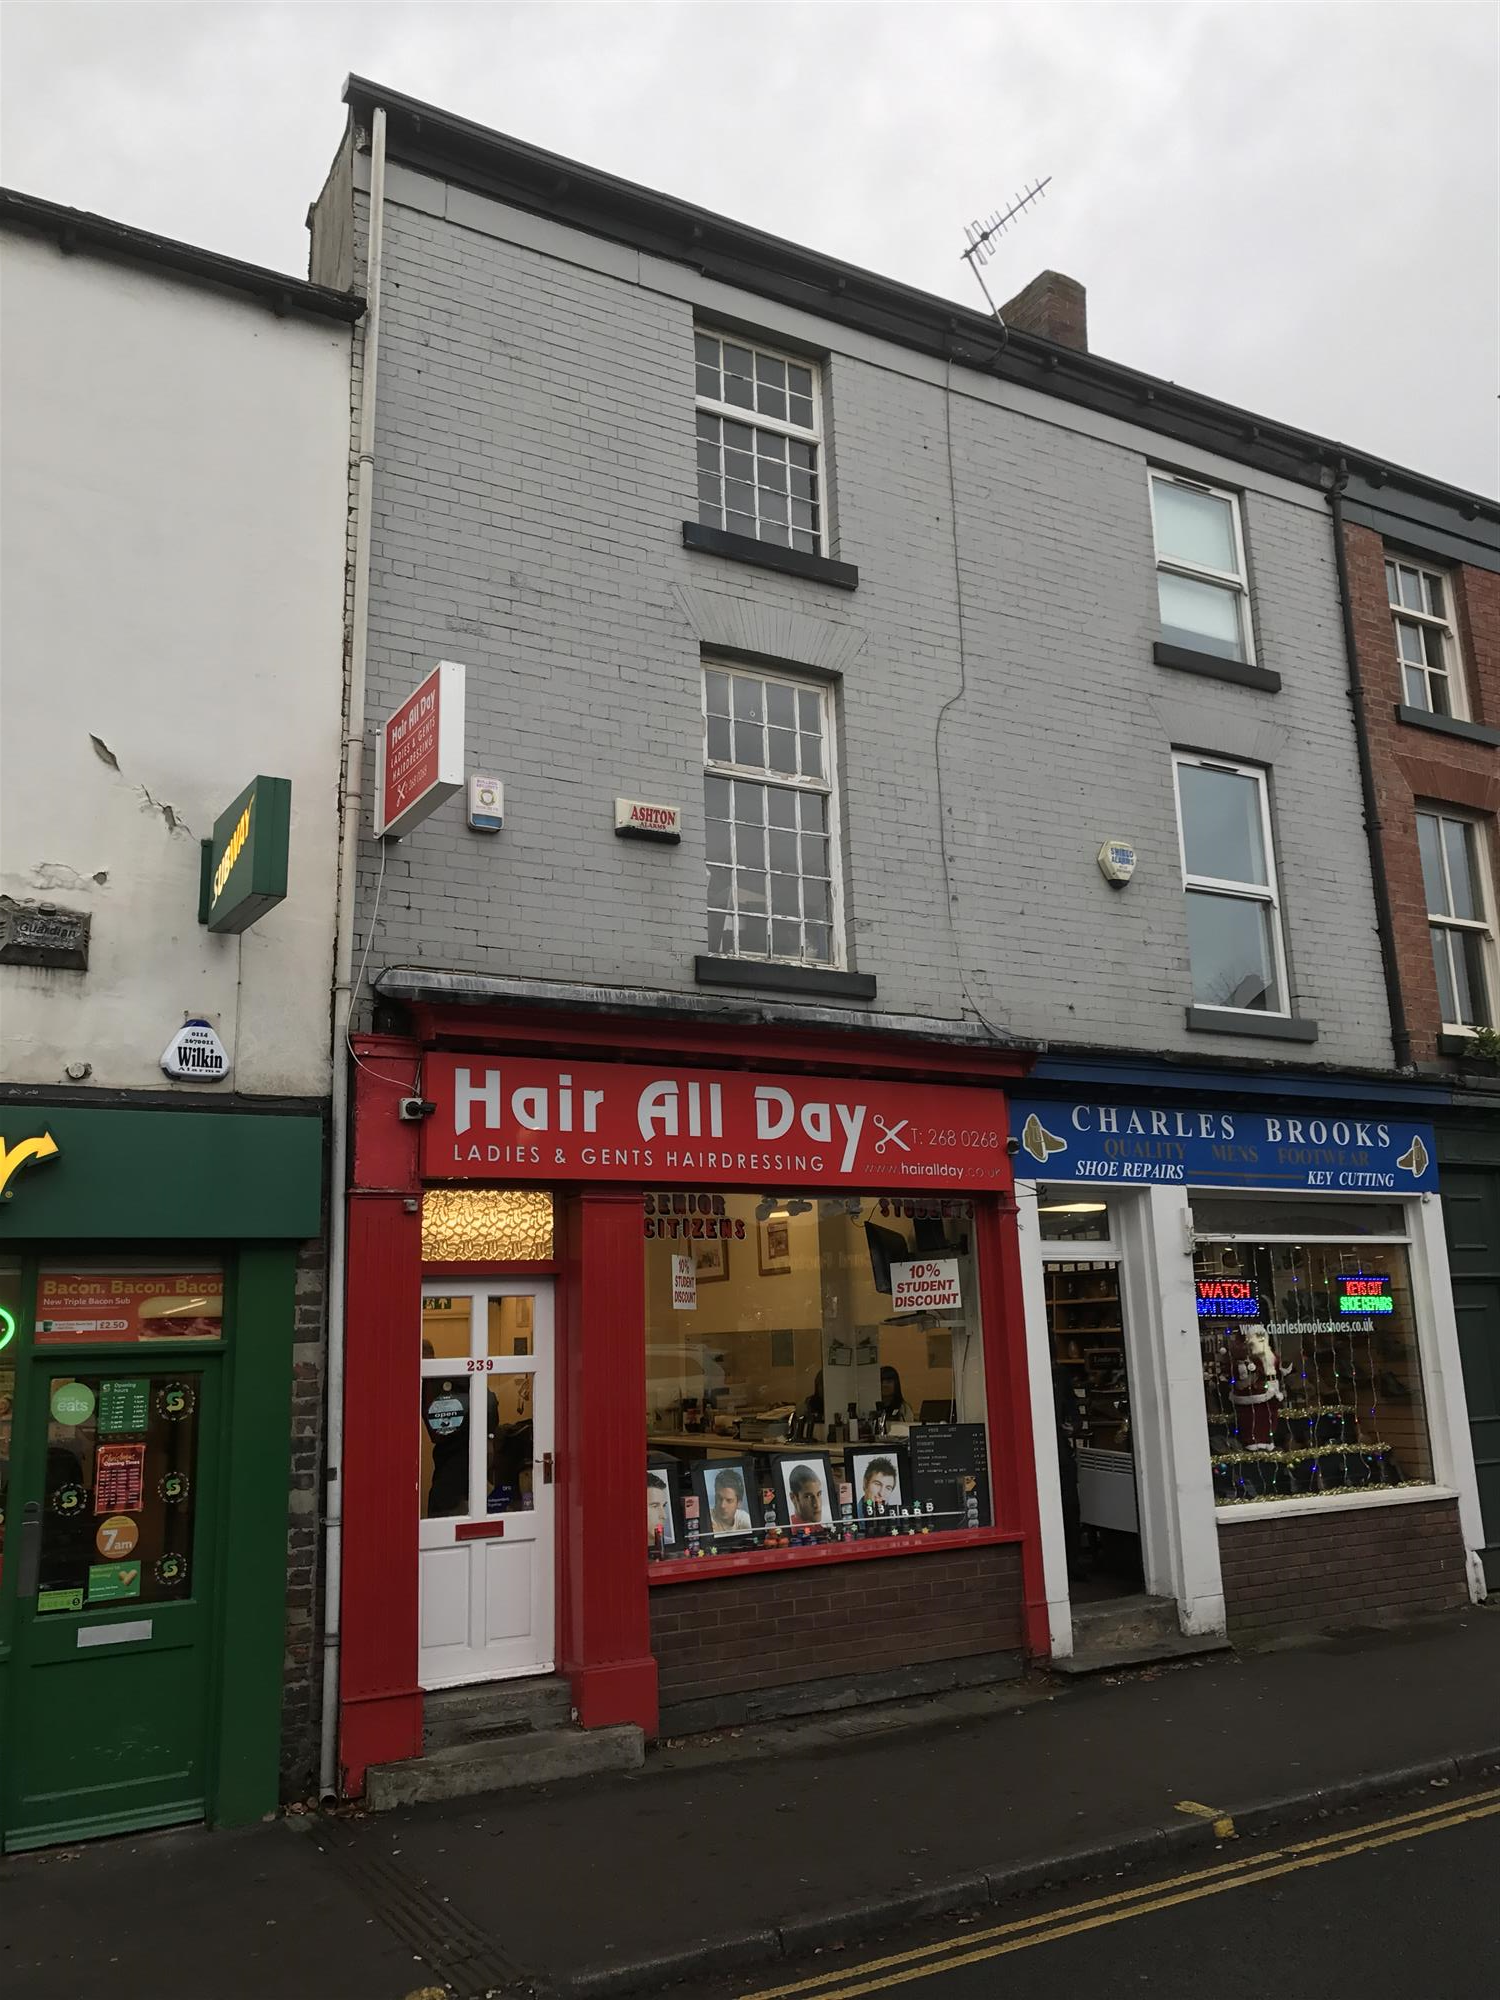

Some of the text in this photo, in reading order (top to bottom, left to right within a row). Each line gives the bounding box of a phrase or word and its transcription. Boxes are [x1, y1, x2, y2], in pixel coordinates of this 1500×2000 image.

[391, 689, 436, 748] Hair All Day
[390, 743, 411, 768] LADIES
[418, 715, 436, 741] GENTS
[392, 734, 433, 781] HAIRDRESSING
[630, 805, 676, 826] ASHTON
[640, 822, 667, 830] ALARMS
[211, 793, 256, 911] SUBWAY
[19, 922, 76, 938] Guardian
[177, 1046, 223, 1069] Wilkin
[455, 1068, 867, 1172] Hair All Day
[1071, 1105, 1390, 1148] CHARLES BROOKS
[911, 1128, 999, 1149] T: 268 0268
[454, 1144, 824, 1171] LADIES & GENTS HAIRDRESSING
[1104, 1138, 1369, 1166] QUALITY MENS FOOTWEAR
[1075, 1160, 1184, 1180] SHOE REPAIRS
[1307, 1170, 1395, 1187] KEY CUTTING
[643, 1193, 726, 1216] SENIOR
[643, 1218, 747, 1240] CITIZENS
[678, 1258, 690, 1275] 10%
[909, 1262, 941, 1279] 10%
[43, 1280, 105, 1295] Bacon.
[111, 1280, 171, 1294] Bacon.
[675, 1275, 695, 1289] STUDENT
[896, 1279, 955, 1294] STUDENT
[1198, 1283, 1250, 1298] WATCH
[1345, 1281, 1382, 1296] KEYS CUT
[43, 1297, 131, 1307] New Triple Bacon Sub
[674, 1290, 696, 1304] DISCOUNT
[894, 1293, 959, 1308] DISCOUNT
[1340, 1296, 1393, 1311] SHOE REPAIRS
[1197, 1299, 1258, 1314] BATTERIES
[99, 1320, 125, 1330] £2.50
[467, 1360, 494, 1372] 239
[57, 1400, 89, 1412] eats
[434, 1411, 457, 1419] open
